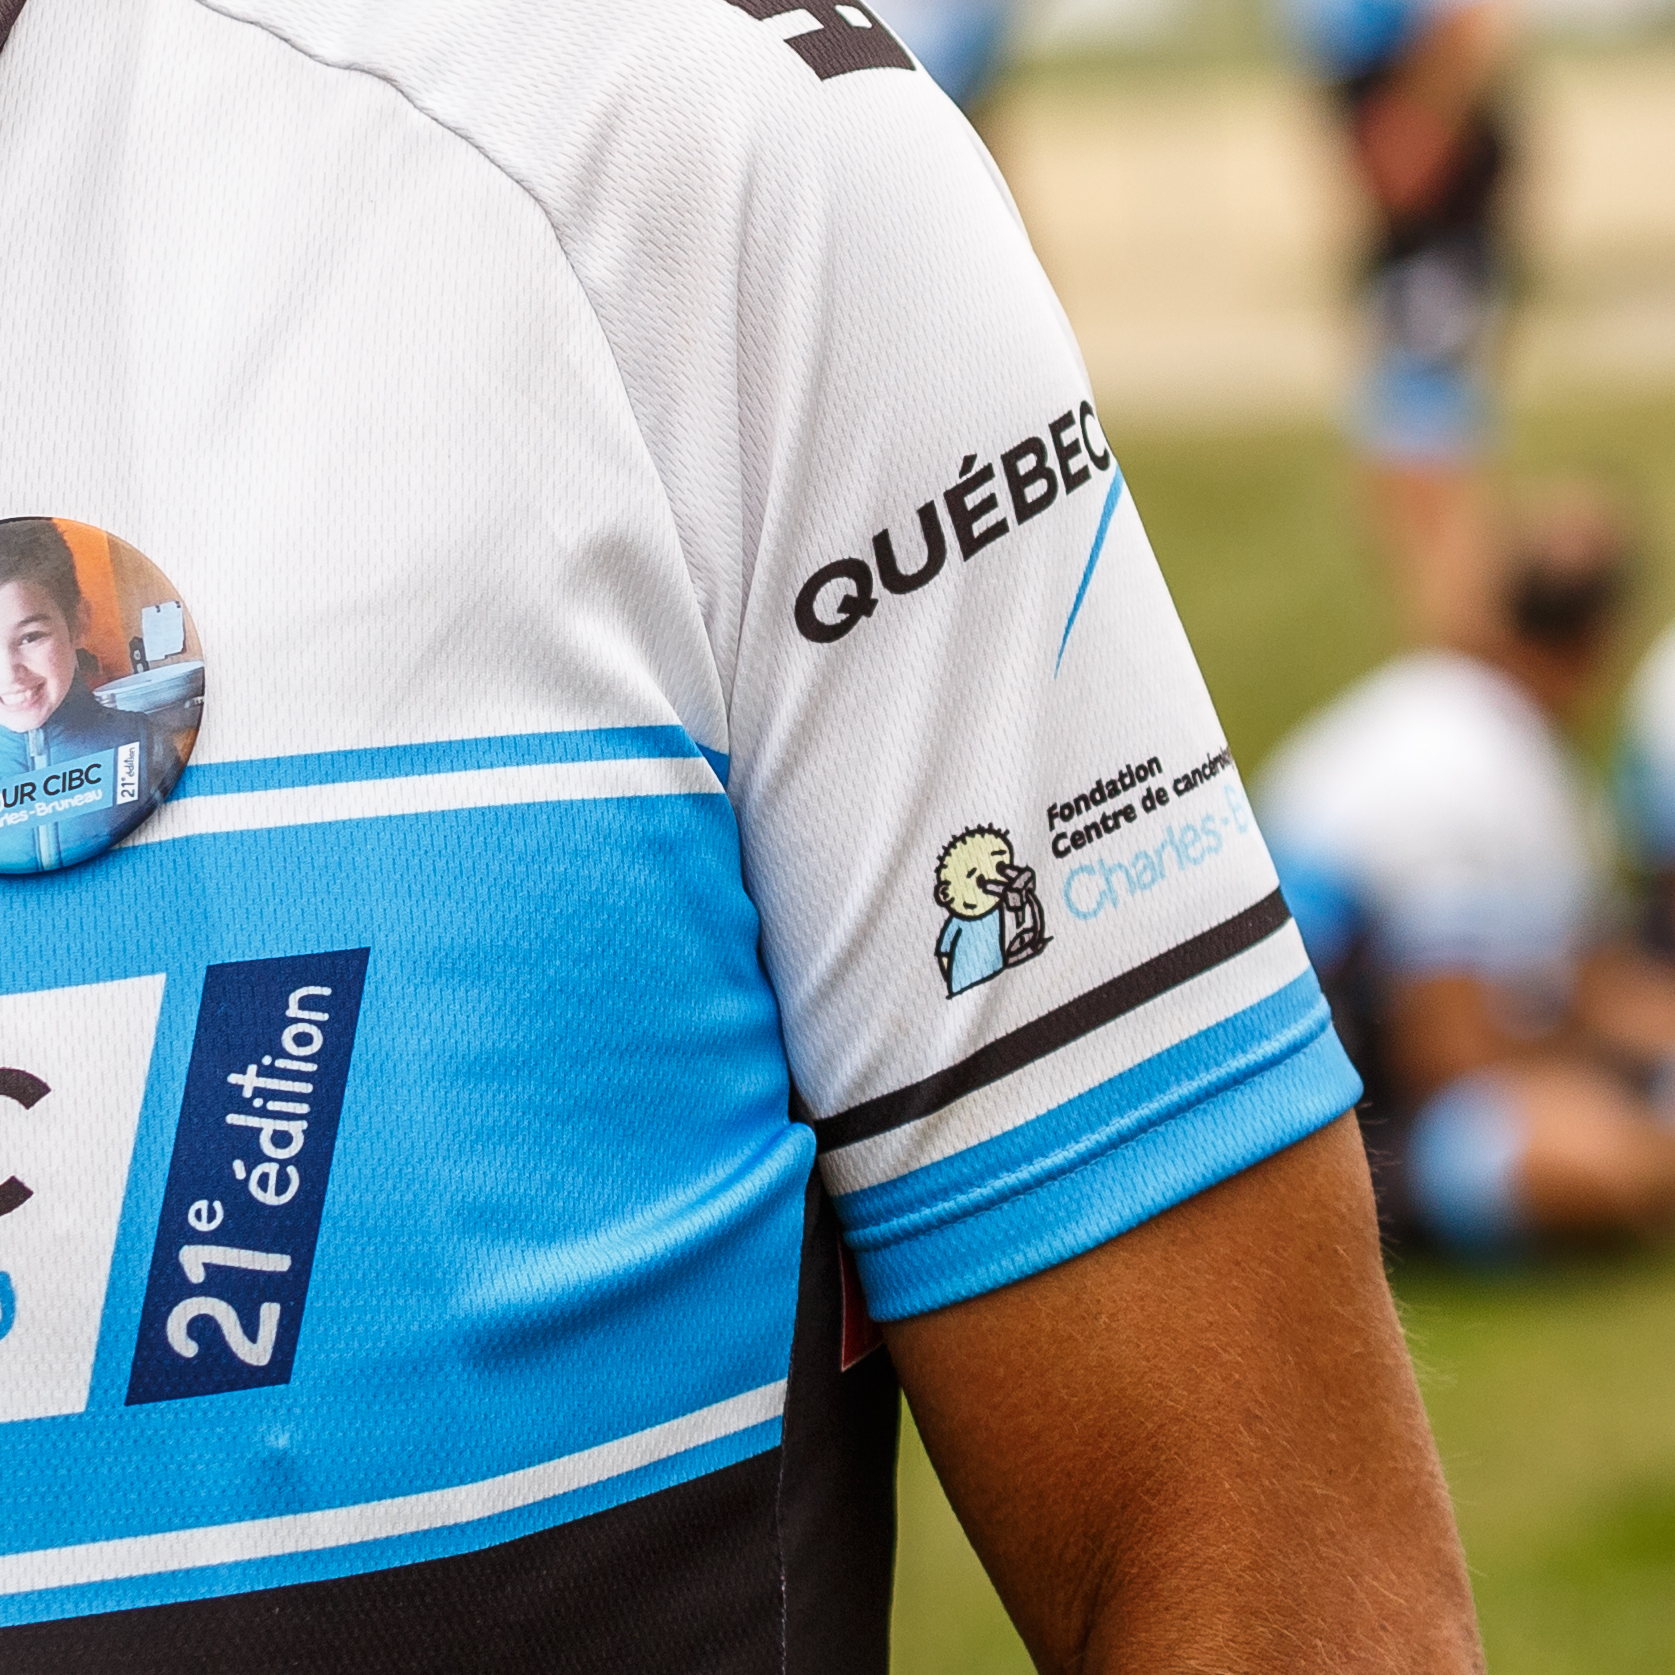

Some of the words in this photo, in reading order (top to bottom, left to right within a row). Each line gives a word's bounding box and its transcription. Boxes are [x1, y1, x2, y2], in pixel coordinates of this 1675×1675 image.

[794, 399, 1112, 645] QUÉBEC
[42, 763, 102, 796] CIBC
[1046, 755, 1163, 832] Fondation
[1050, 802, 1138, 859] Centre
[1140, 786, 1171, 814] de
[225, 985, 333, 1206] édition
